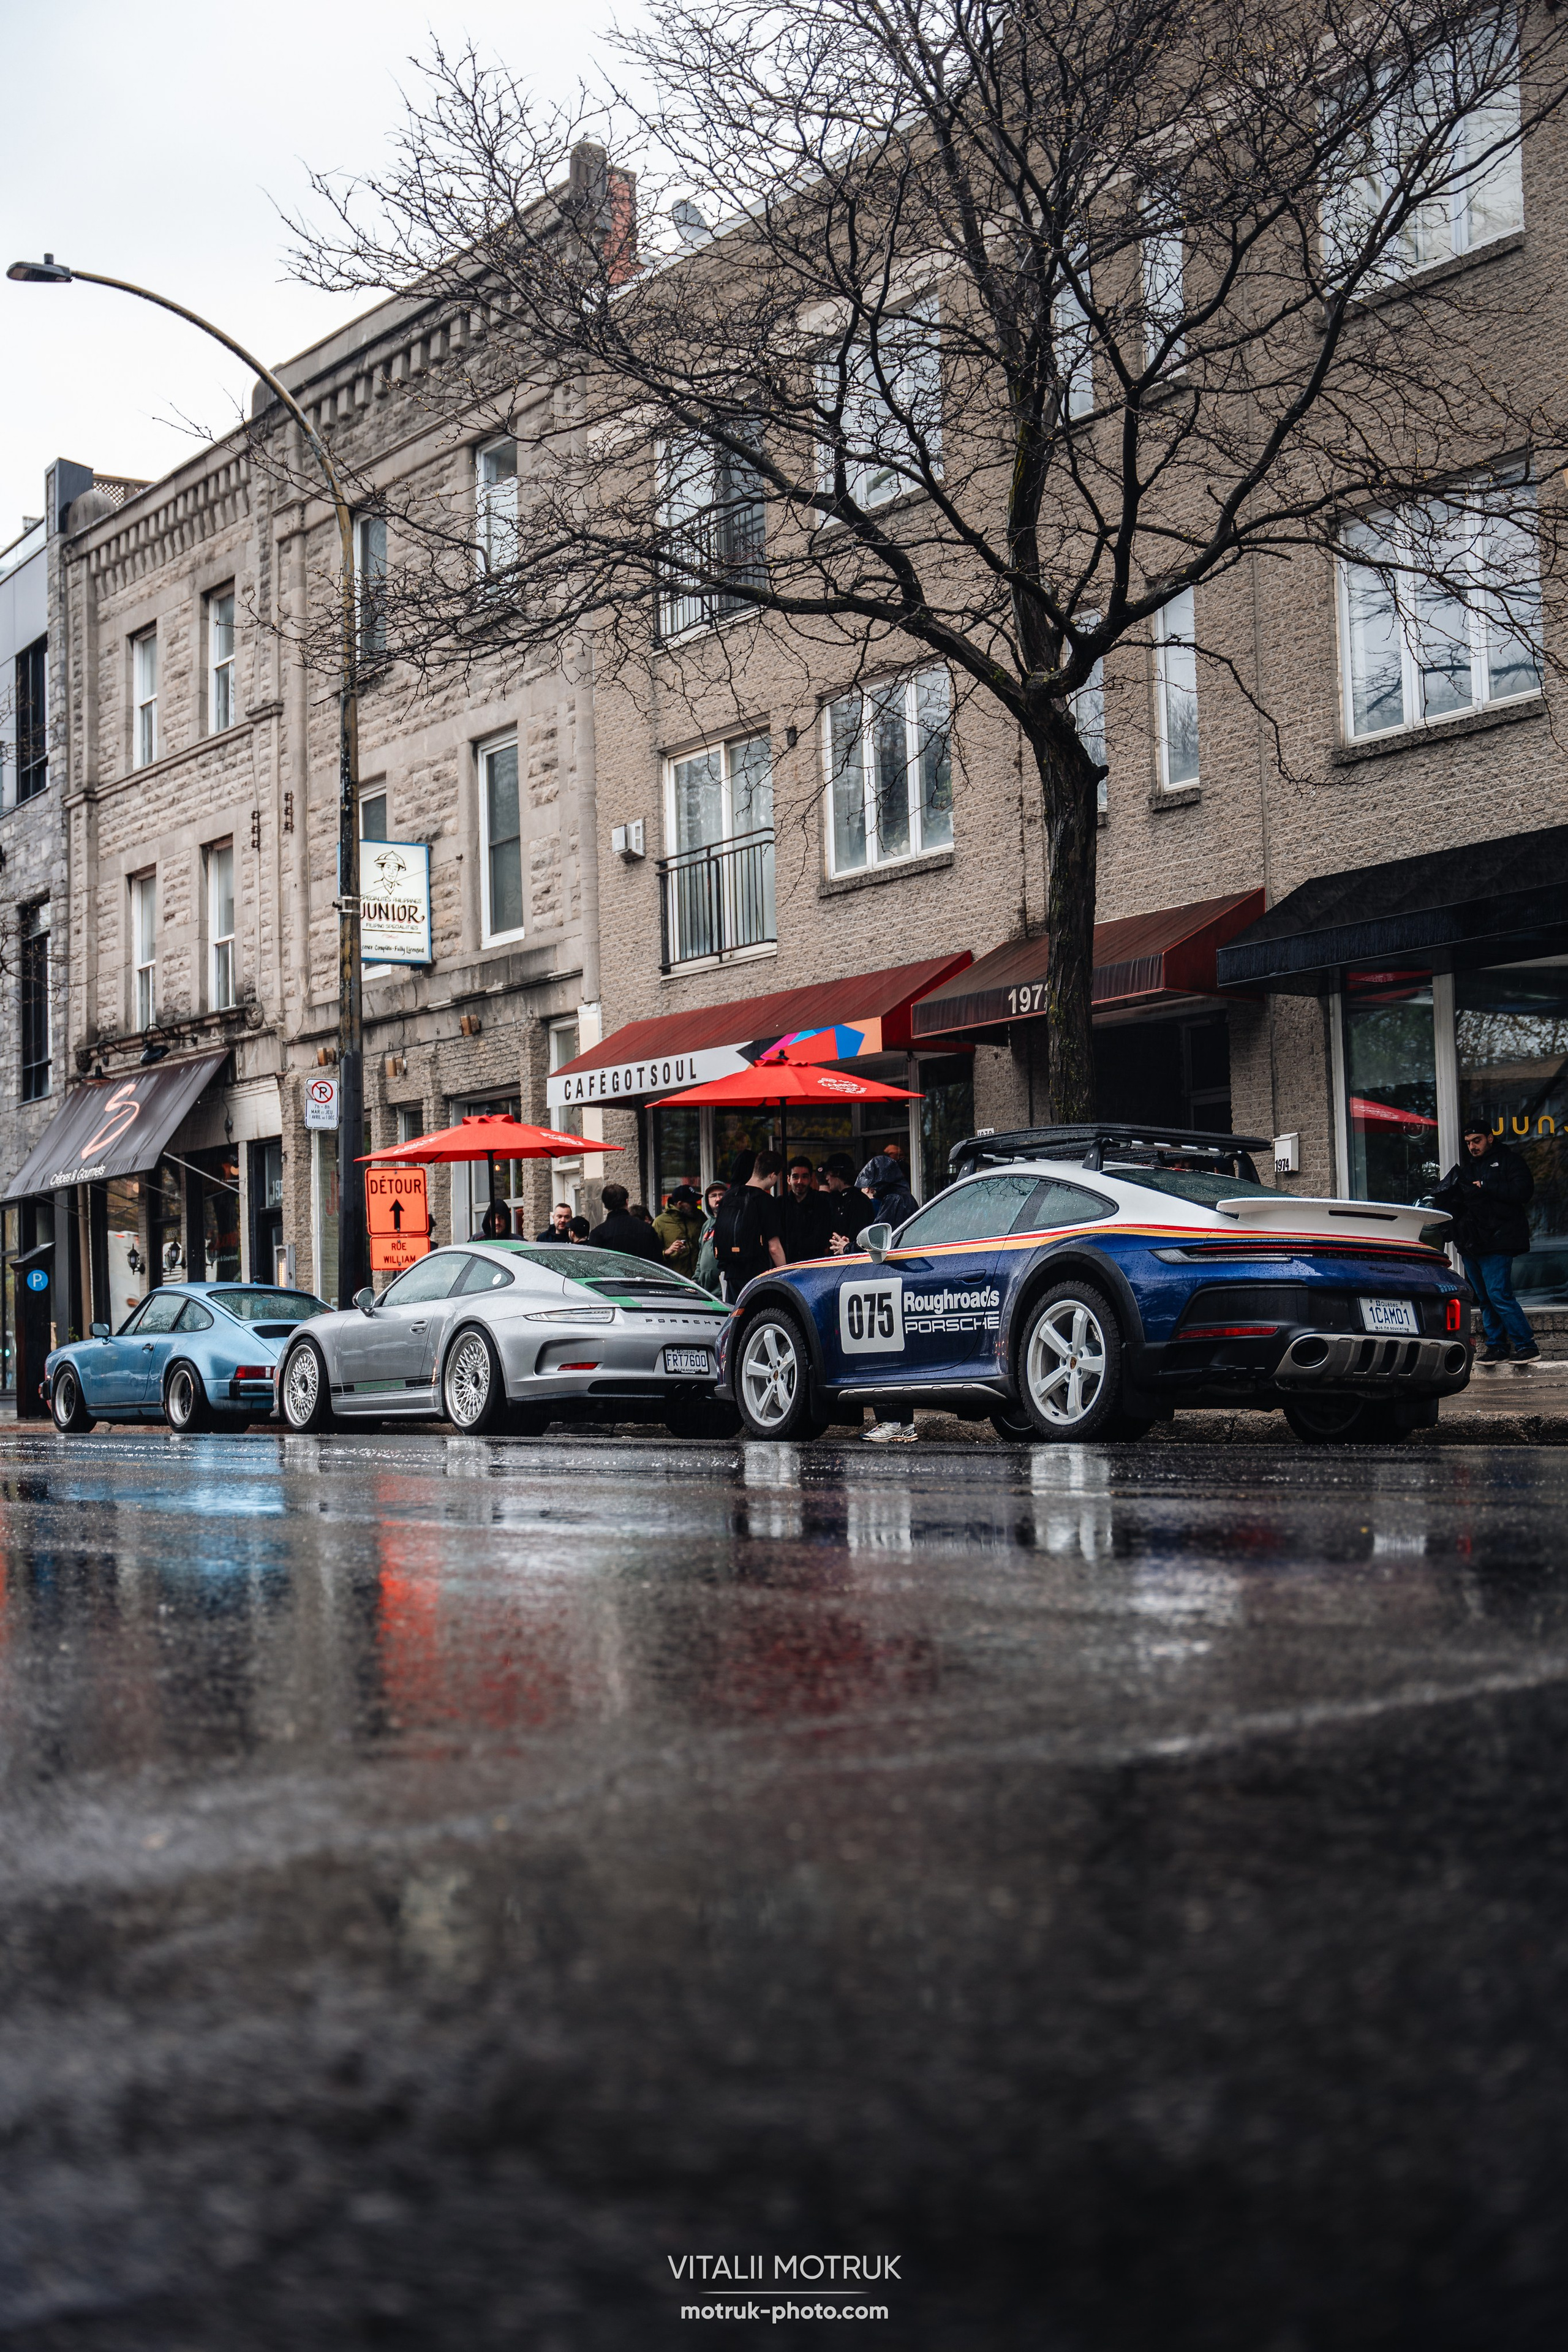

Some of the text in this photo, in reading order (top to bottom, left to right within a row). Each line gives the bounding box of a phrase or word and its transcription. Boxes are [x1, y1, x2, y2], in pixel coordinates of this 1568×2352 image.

[360, 902, 425, 924] JUNIOR
[1008, 982, 1048, 1014] 197
[1275, 1158, 1289, 1172] 1974
[370, 1175, 421, 1194] DÉTOUR
[904, 1286, 999, 1314] Roughroads
[848, 1292, 894, 1340] 075
[905, 1316, 999, 1334] PORSCHE
[666, 1354, 706, 1367] FRT7600
